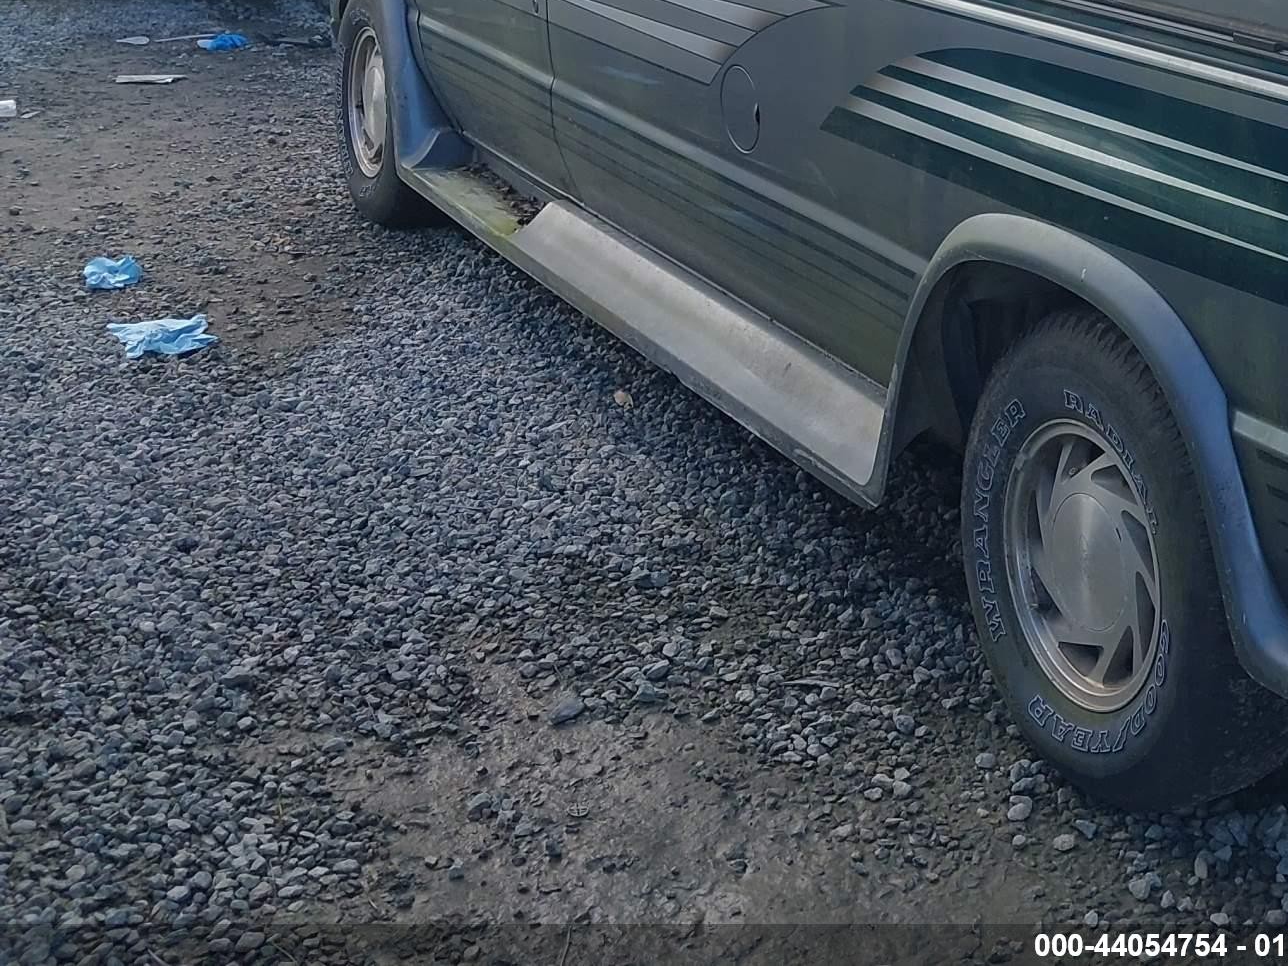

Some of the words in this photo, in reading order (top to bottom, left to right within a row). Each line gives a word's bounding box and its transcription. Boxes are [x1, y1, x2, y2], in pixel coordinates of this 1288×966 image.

[973, 398, 1026, 642] WRANGLER
[1063, 389, 1158, 534] RADIAL
[1027, 618, 1171, 754] GOODYEAR
